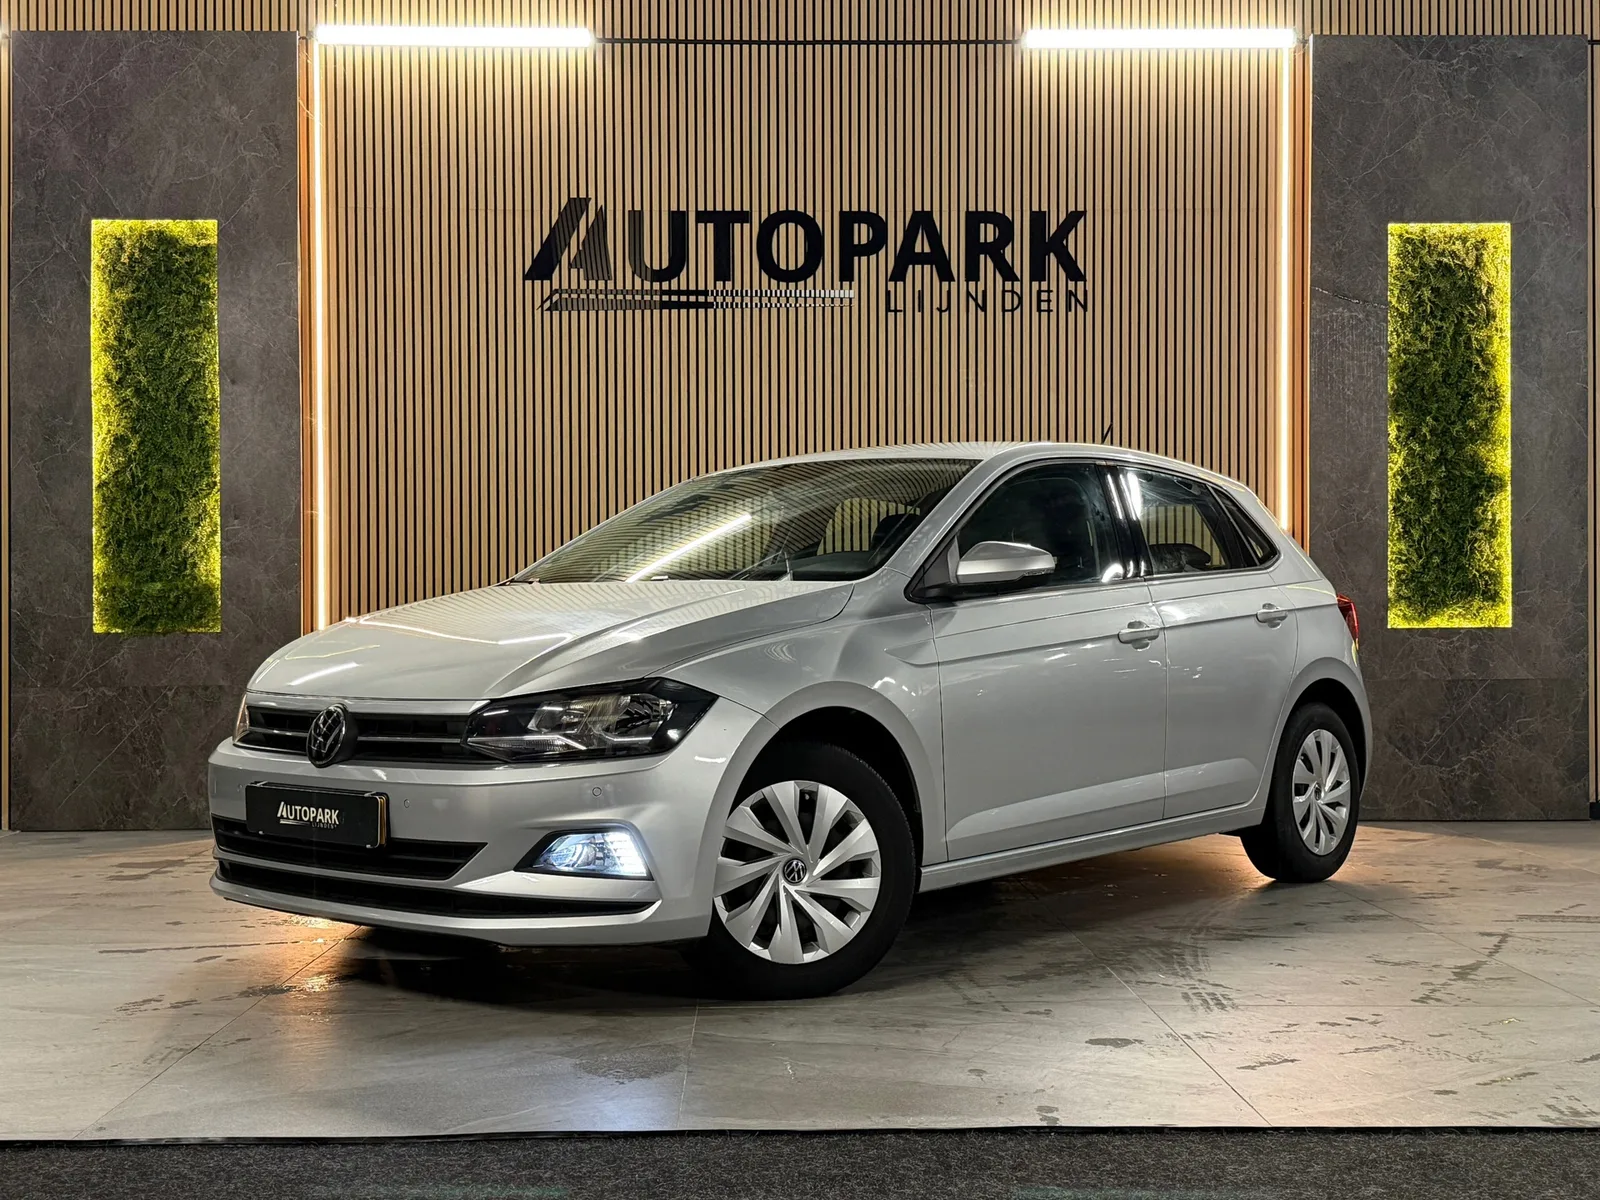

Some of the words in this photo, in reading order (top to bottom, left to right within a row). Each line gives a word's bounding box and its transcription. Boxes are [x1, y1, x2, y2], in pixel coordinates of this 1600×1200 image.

[524, 197, 1088, 282] AUTOPARK
[886, 289, 1089, 313] LIJNDEN
[276, 801, 340, 825] AUTOPARK
